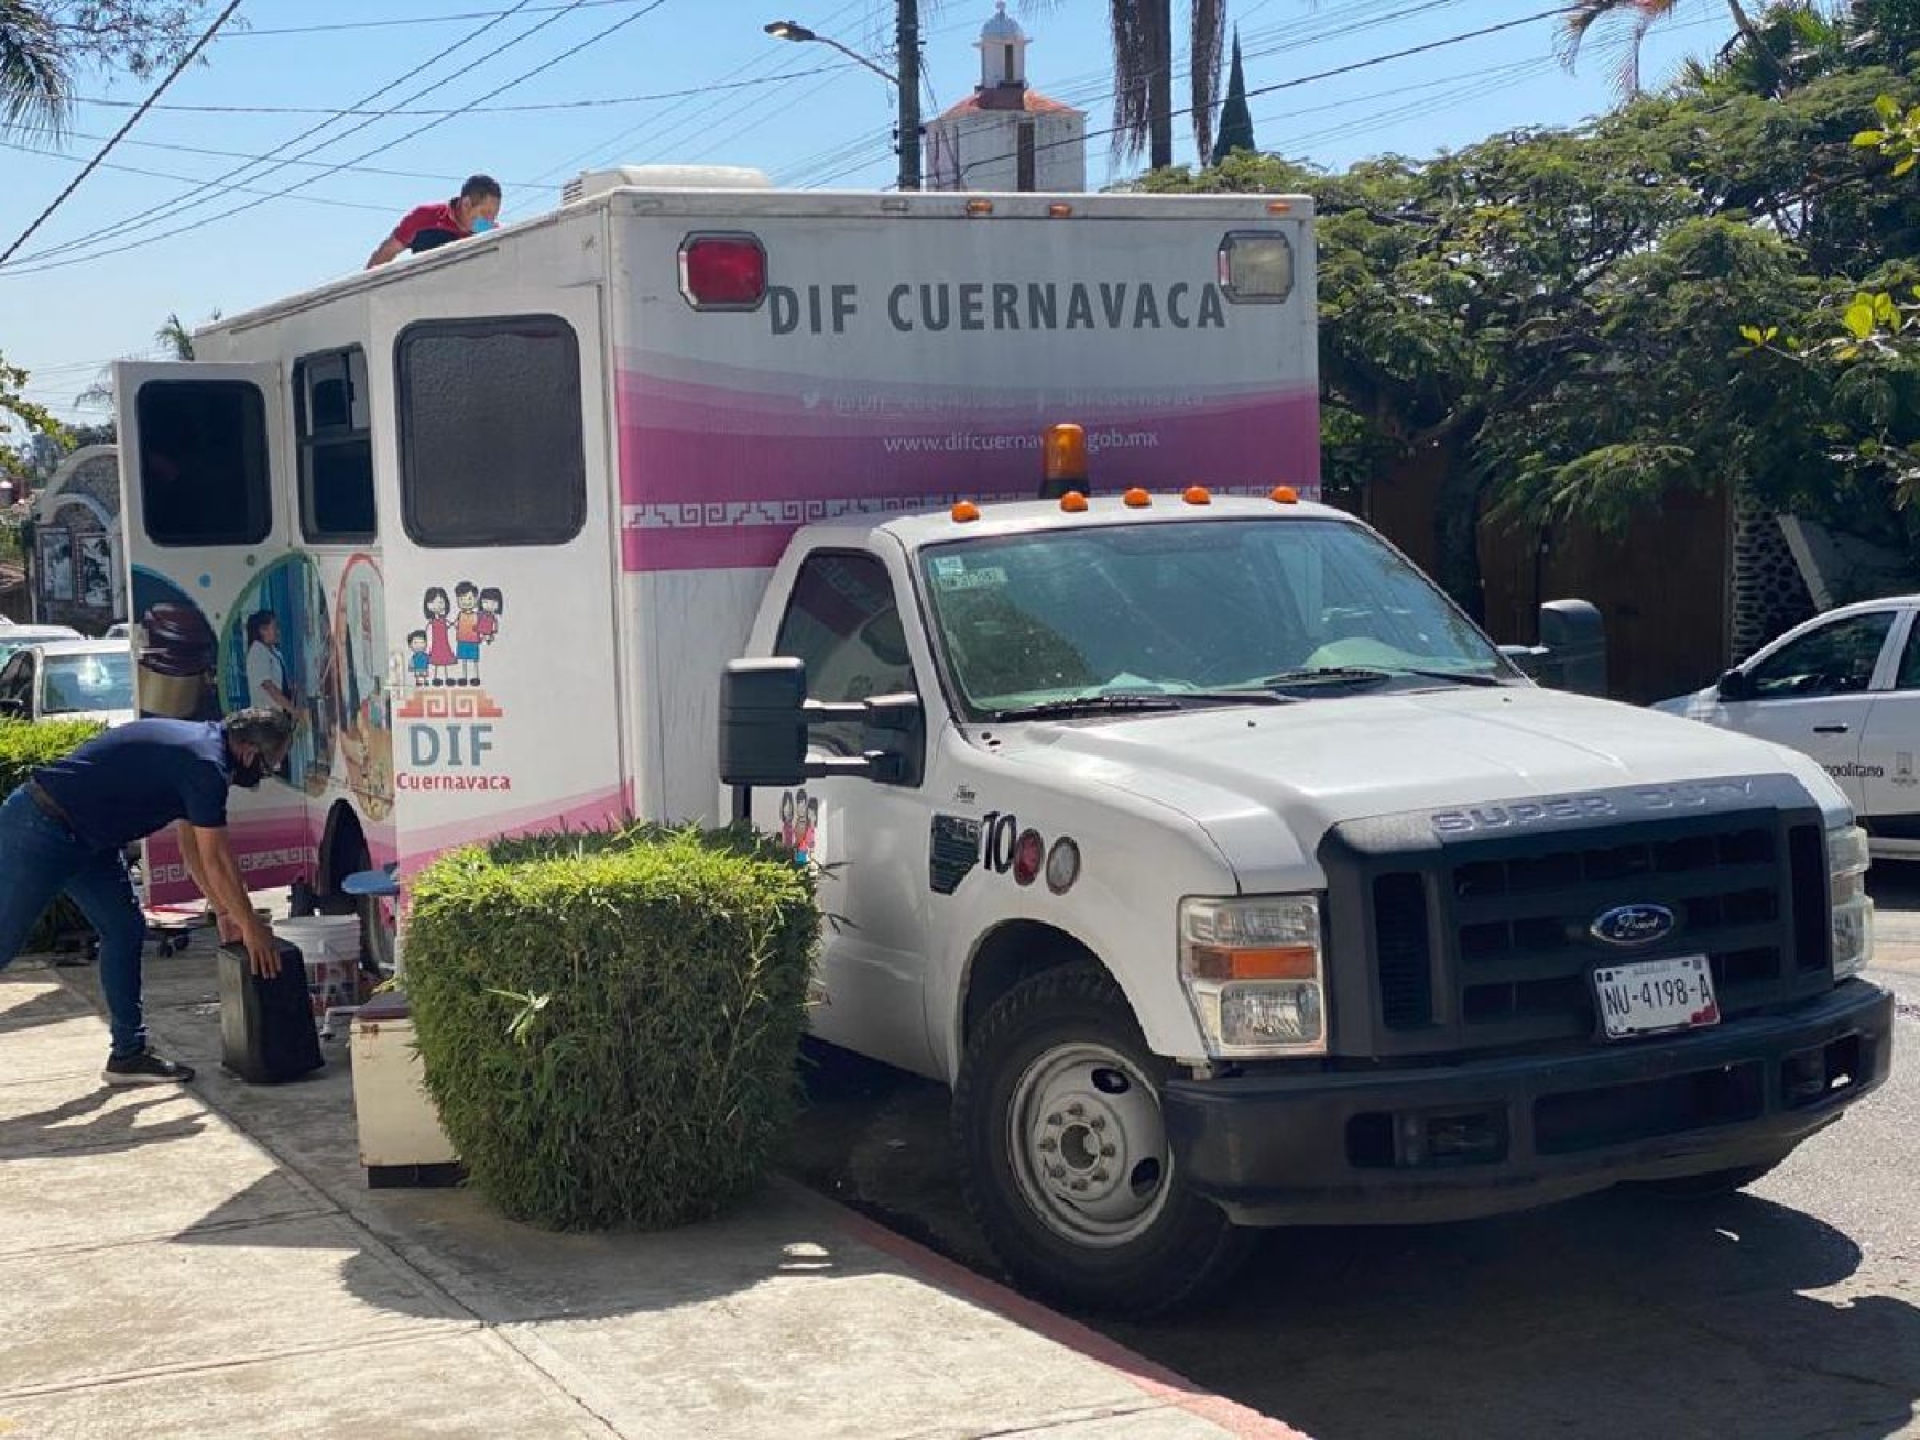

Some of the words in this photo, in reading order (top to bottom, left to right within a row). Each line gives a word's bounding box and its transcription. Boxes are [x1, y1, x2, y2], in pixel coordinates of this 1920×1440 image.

[769, 284, 858, 335] DIF
[887, 282, 1225, 333] CUERNAVACA
[409, 723, 492, 766] DIF
[396, 772, 511, 790] Cuernavaca
[1431, 796, 1617, 832] SUPER
[983, 811, 1017, 874] 10
[1614, 912, 1660, 937] Ford
[1604, 973, 1711, 1015] NU-4198-A
